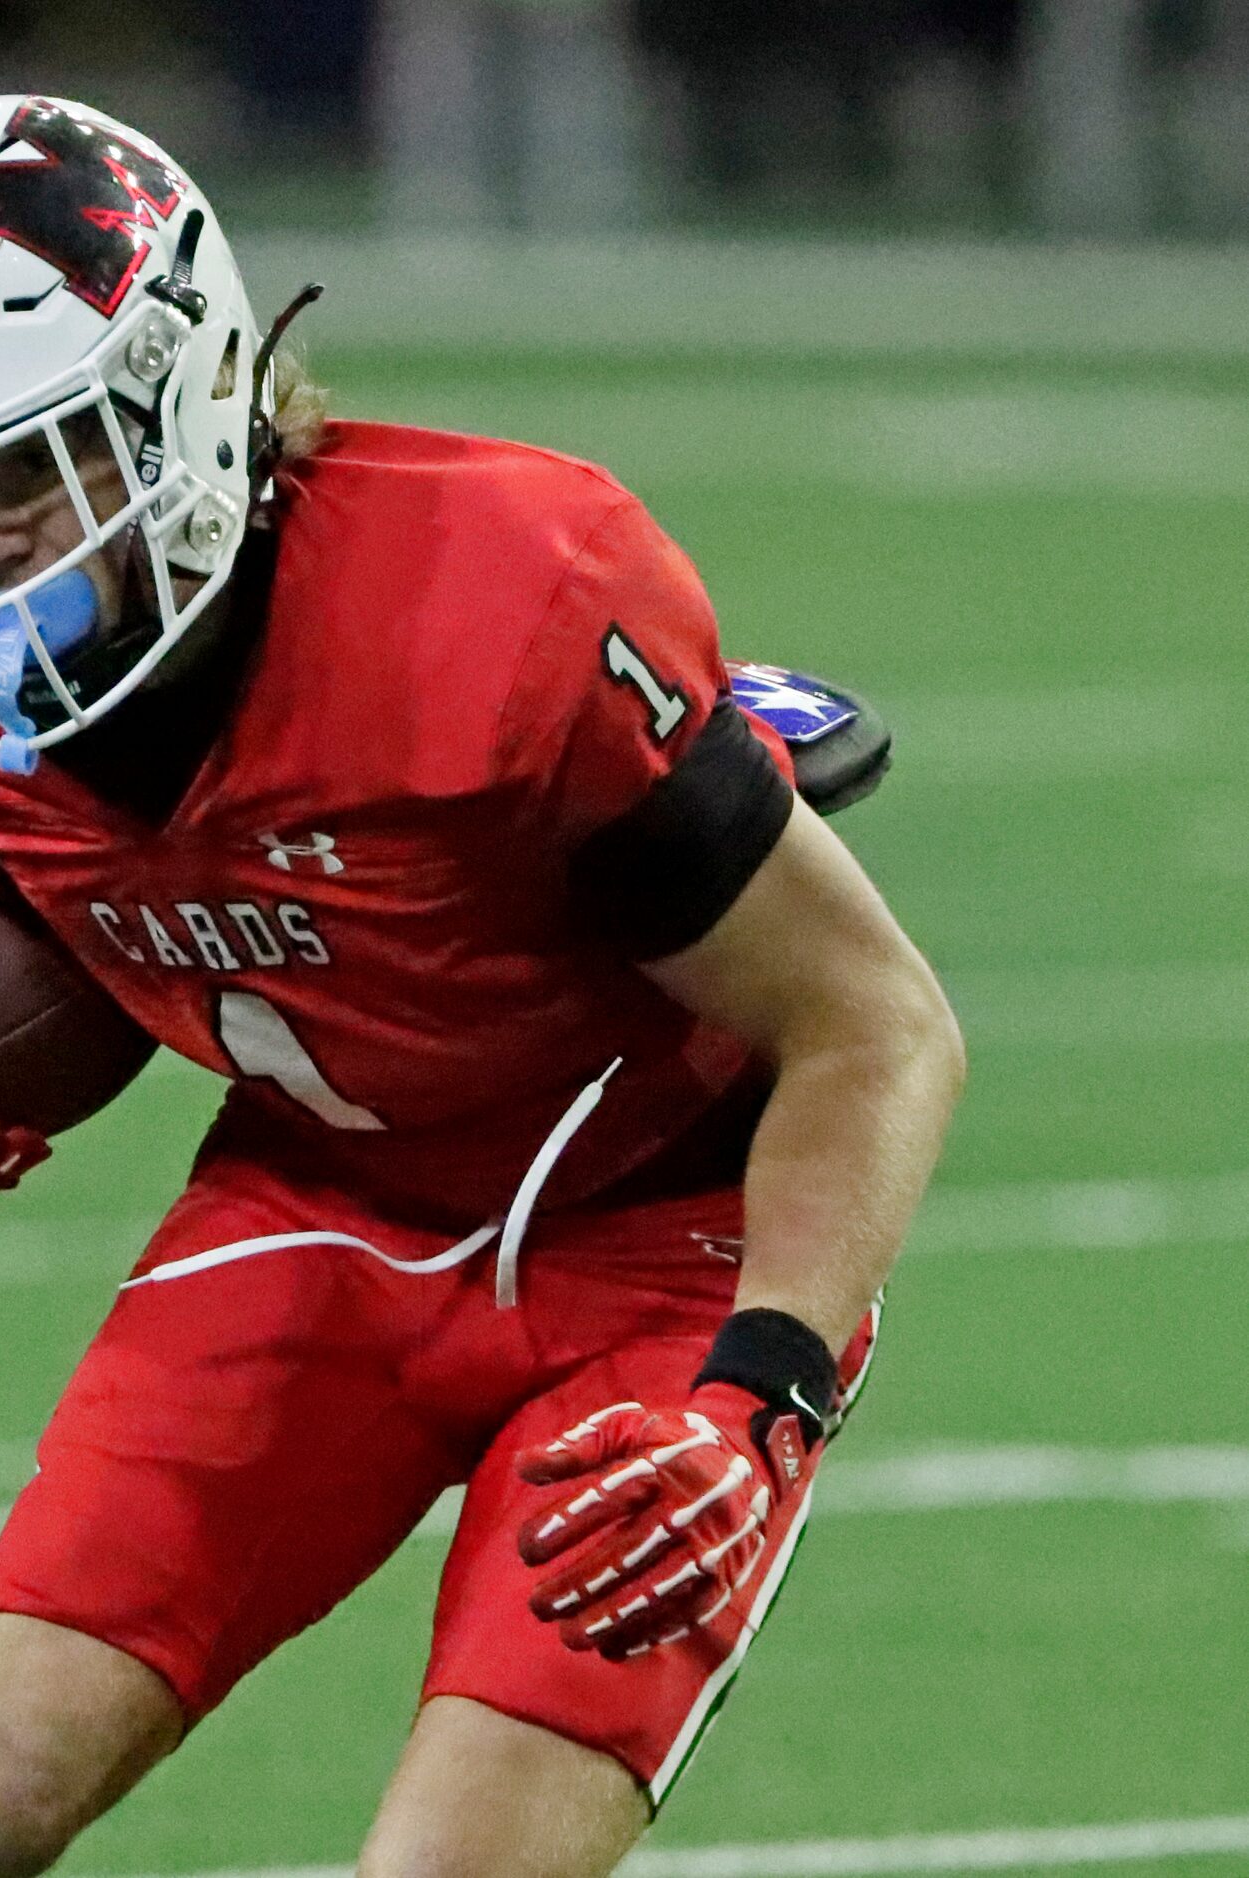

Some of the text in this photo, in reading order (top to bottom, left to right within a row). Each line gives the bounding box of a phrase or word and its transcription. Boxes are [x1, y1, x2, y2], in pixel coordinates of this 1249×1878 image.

[604, 626, 689, 742] 1
[90, 901, 331, 971] CARDS
[218, 989, 391, 1131] 1
